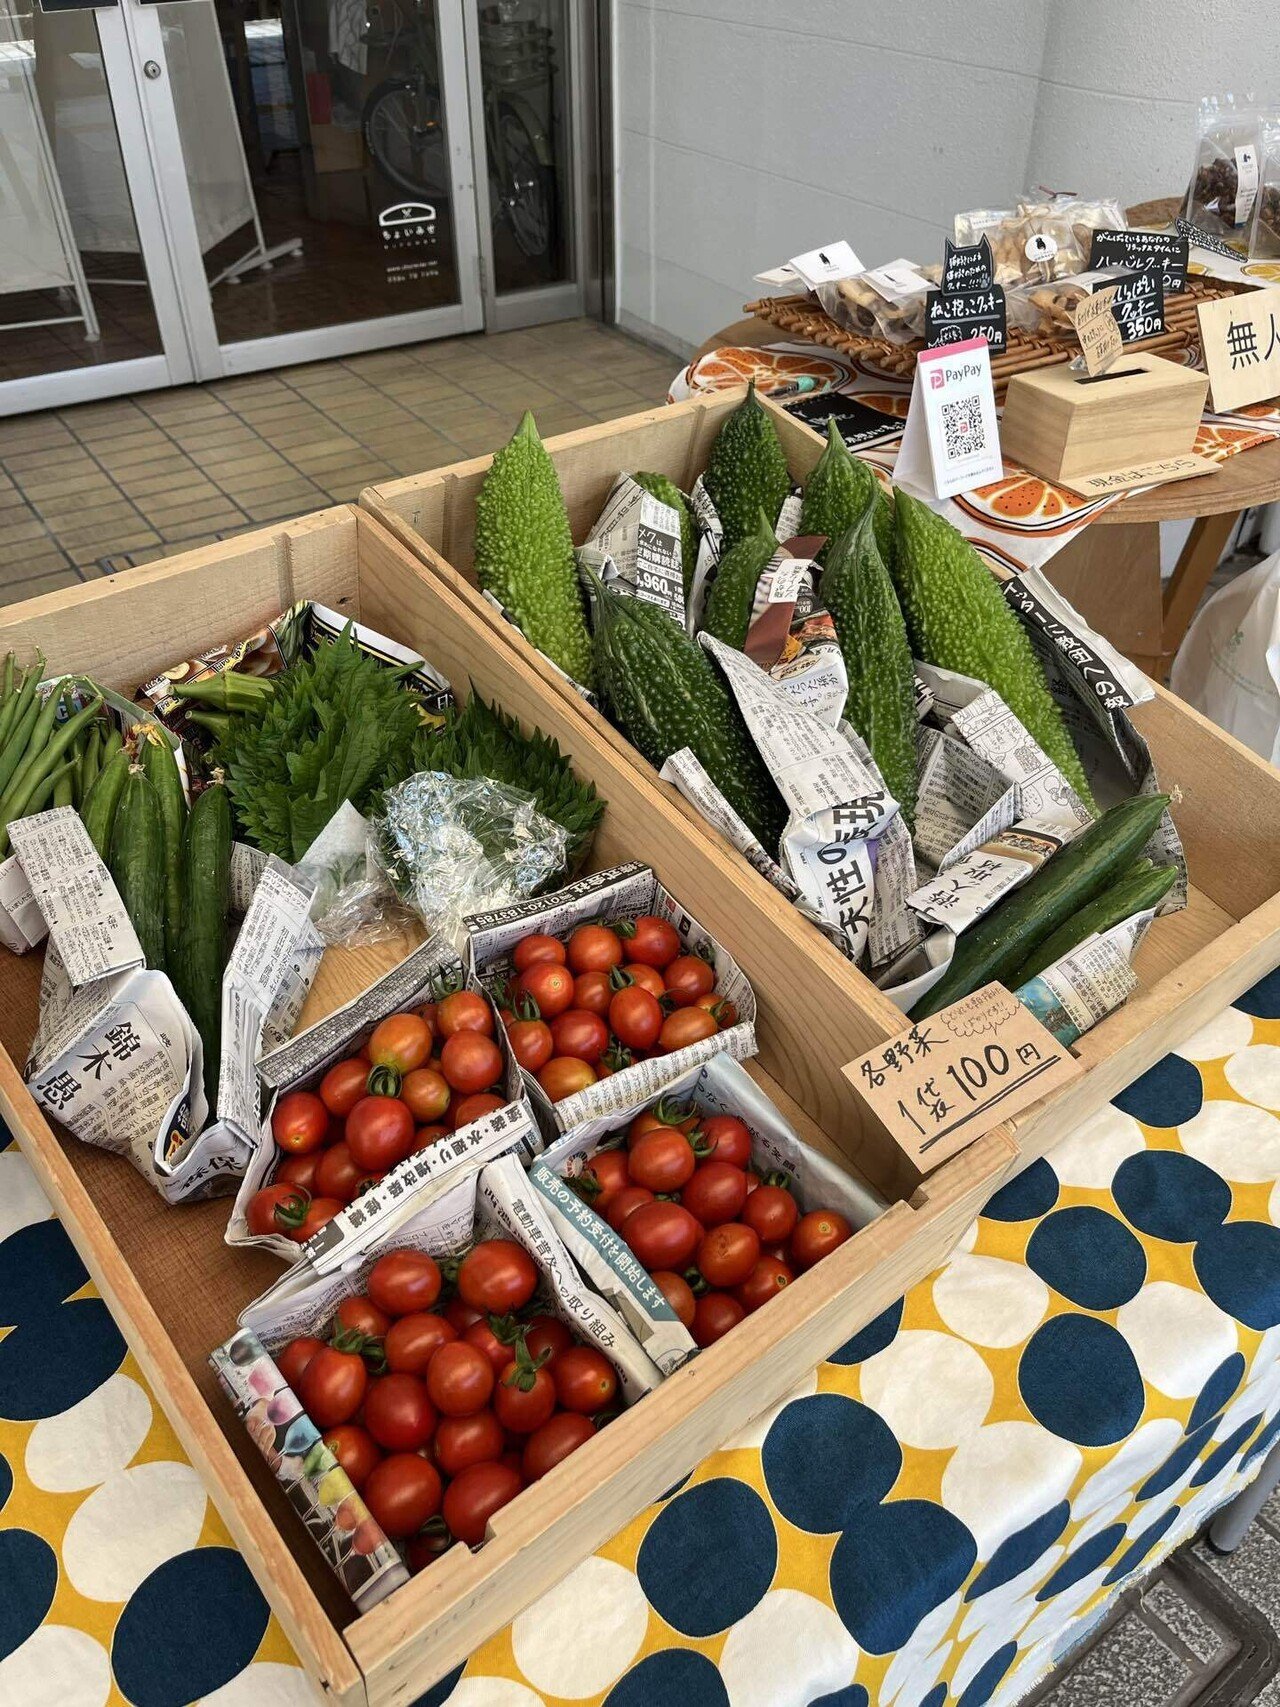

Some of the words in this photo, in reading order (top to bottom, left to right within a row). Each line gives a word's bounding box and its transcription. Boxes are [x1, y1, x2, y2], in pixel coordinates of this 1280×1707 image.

[1127, 317, 1162, 340] 350円
[945, 363, 982, 383] PayPay
[860, 1025, 949, 1089] 各野菜
[534, 1165, 667, 1311] 販売の予約受付を開始します
[510, 1197, 619, 1348] 電動車普及への取り組み
